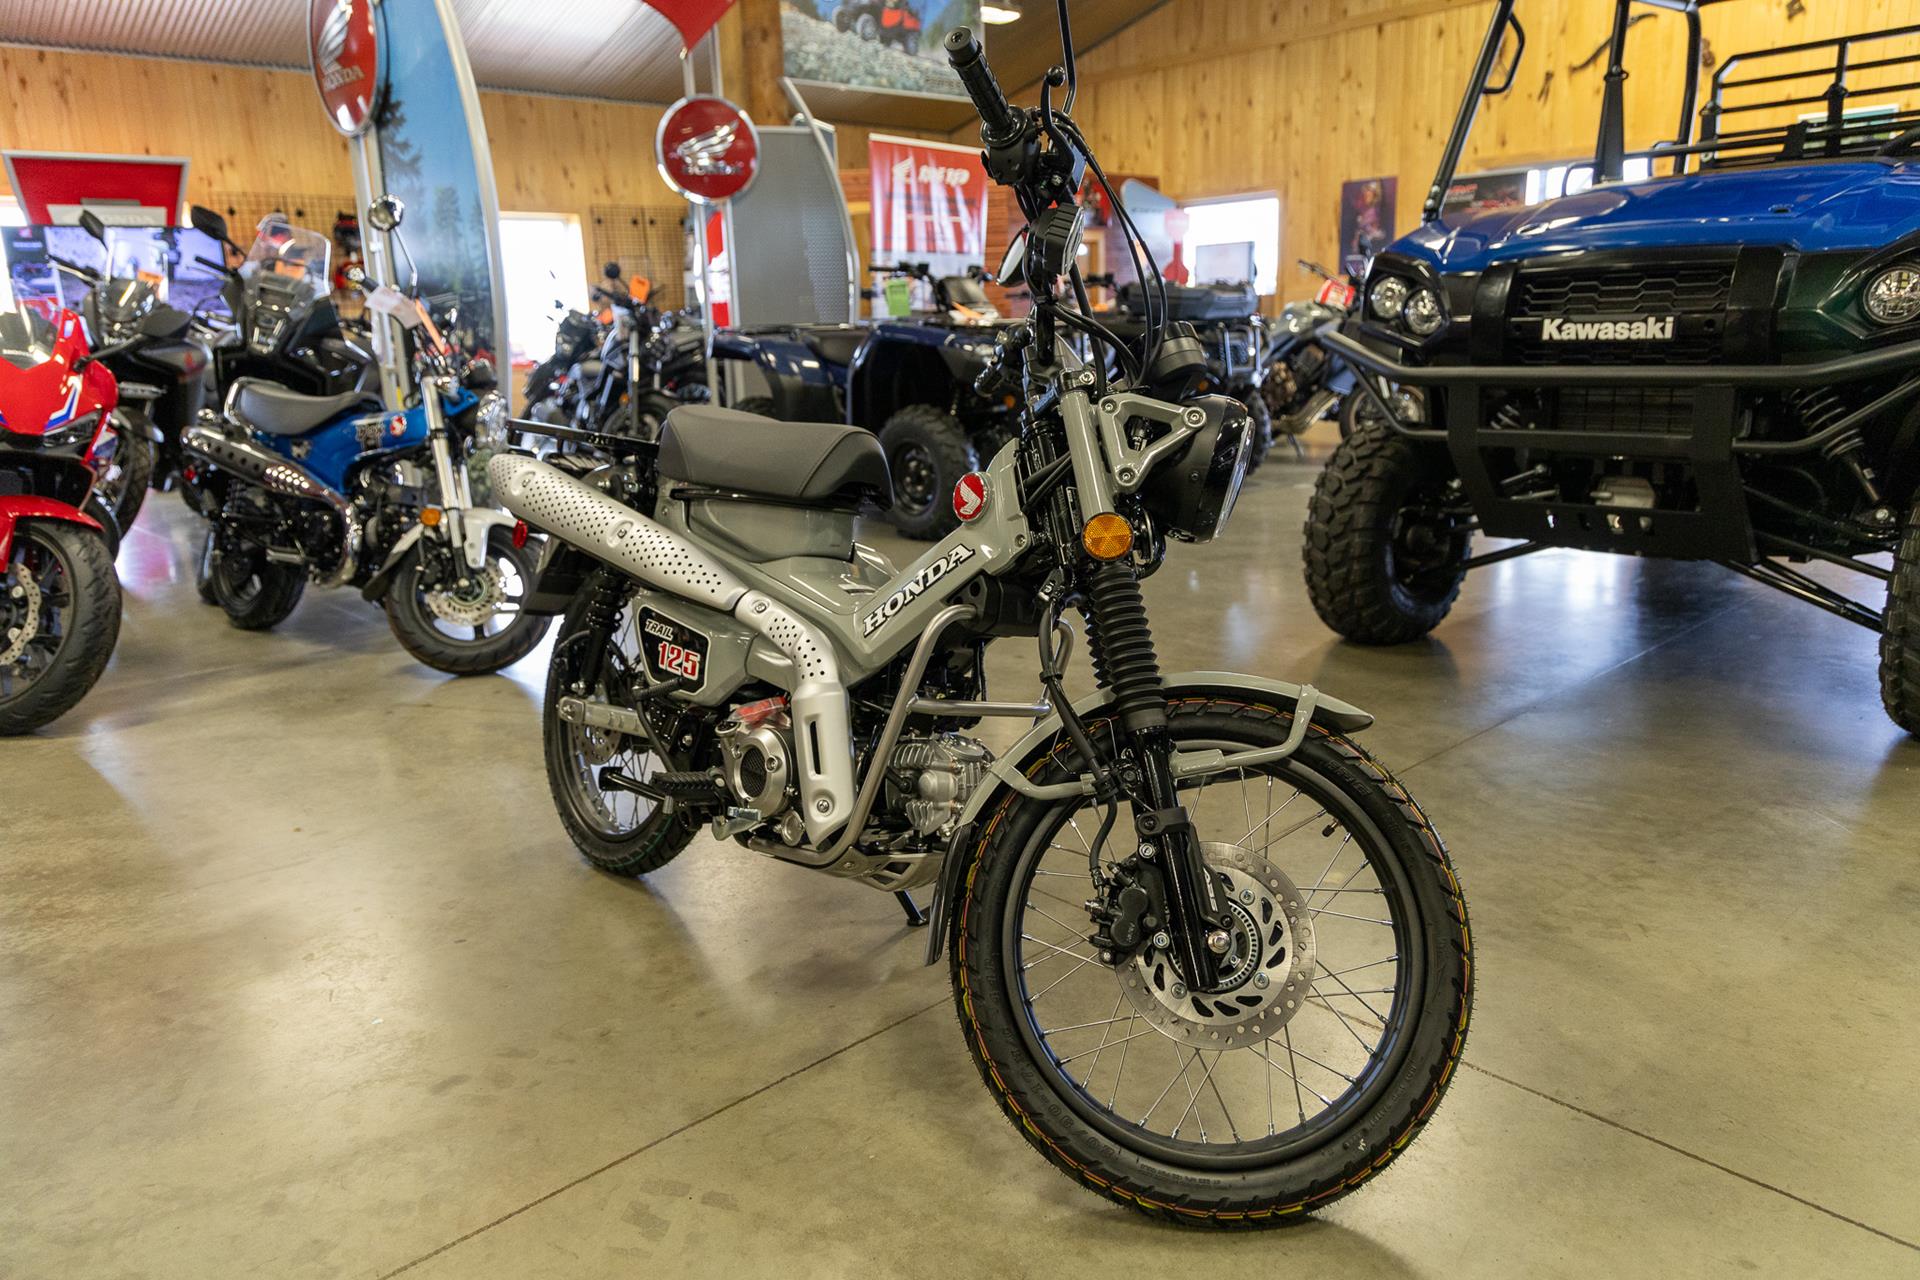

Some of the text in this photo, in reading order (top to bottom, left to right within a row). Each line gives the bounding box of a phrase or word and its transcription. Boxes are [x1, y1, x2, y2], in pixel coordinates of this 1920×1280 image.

[1541, 316, 1675, 341] Kawasaki
[863, 543, 976, 638] HONDA
[644, 618, 674, 641] TRAIL
[658, 641, 701, 681] 125
